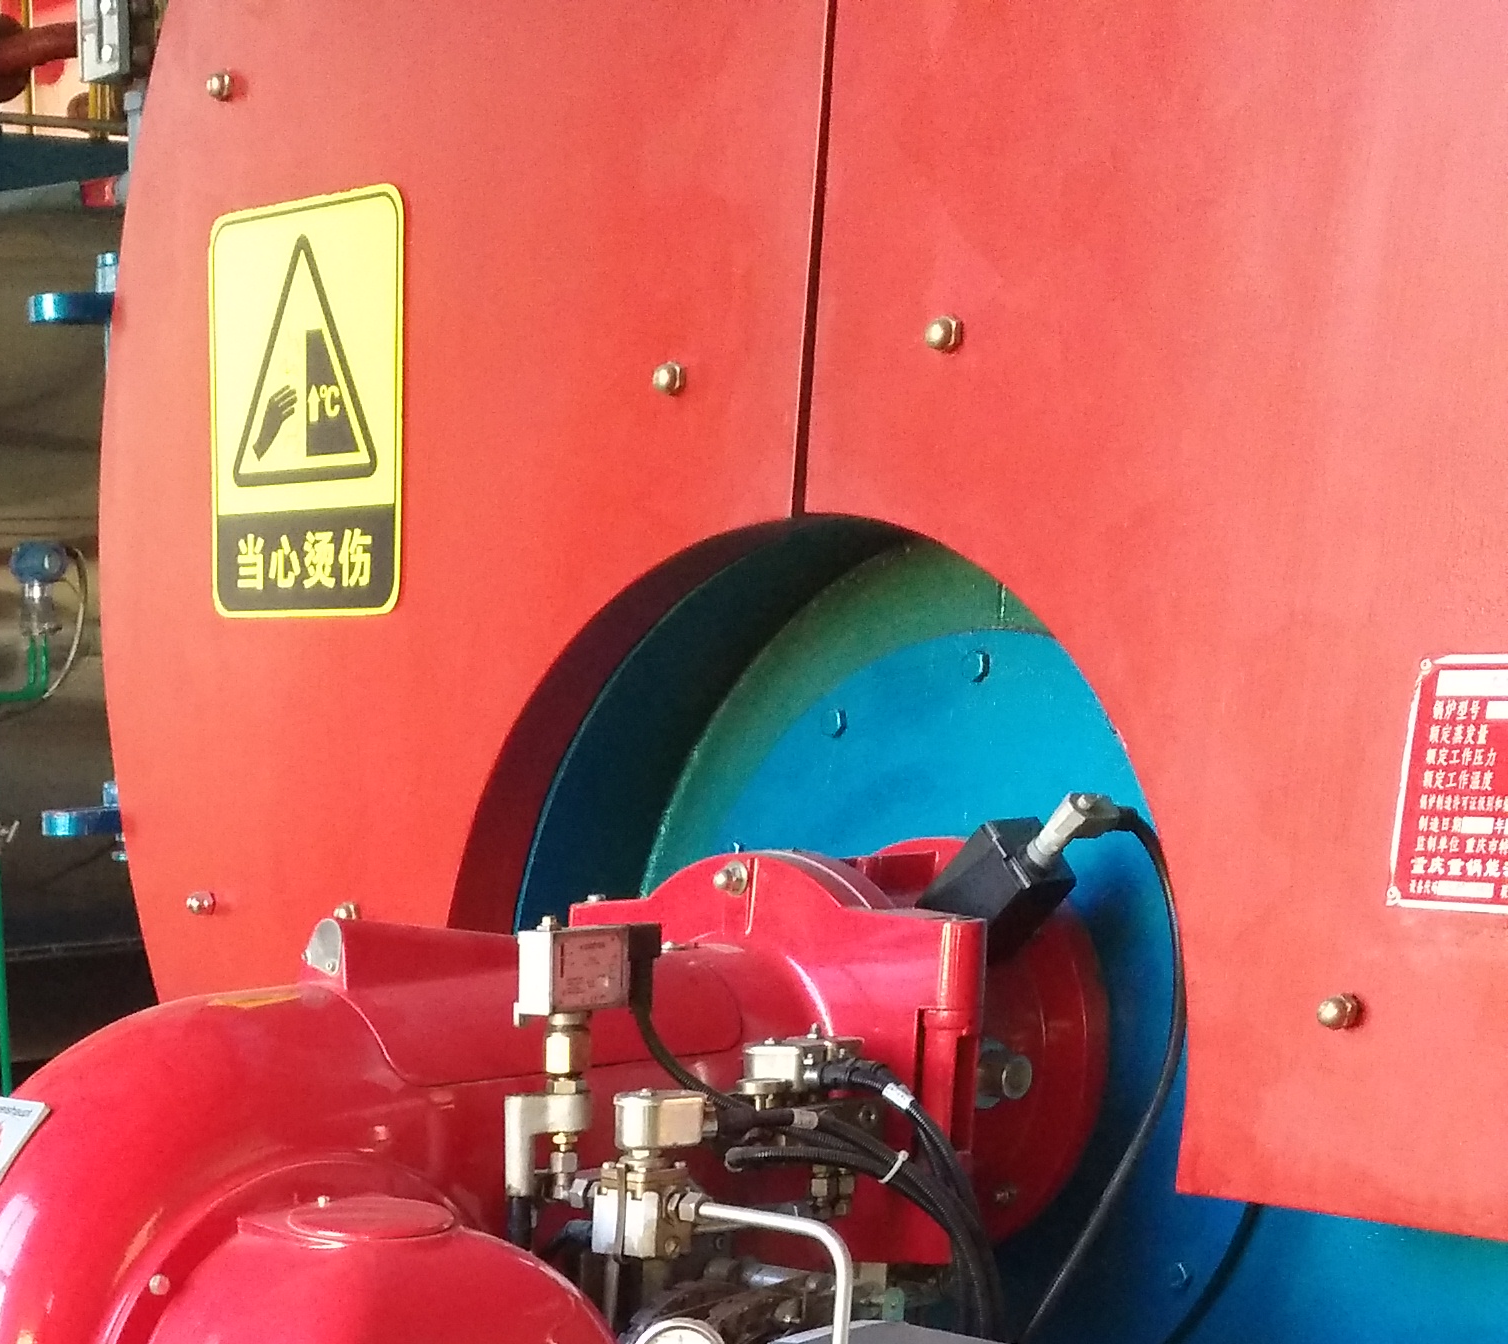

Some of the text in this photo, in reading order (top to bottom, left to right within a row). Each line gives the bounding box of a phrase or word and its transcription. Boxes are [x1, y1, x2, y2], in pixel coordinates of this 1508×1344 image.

[236, 527, 373, 592] 当心烫伤
[1432, 699, 1481, 720] 锅炉型号
[1428, 723, 1489, 745] 额定蒸发量
[1425, 747, 1497, 767] 额定工作压力
[1422, 769, 1495, 791] 额定工作温度
[1414, 835, 1460, 853] 监制单位
